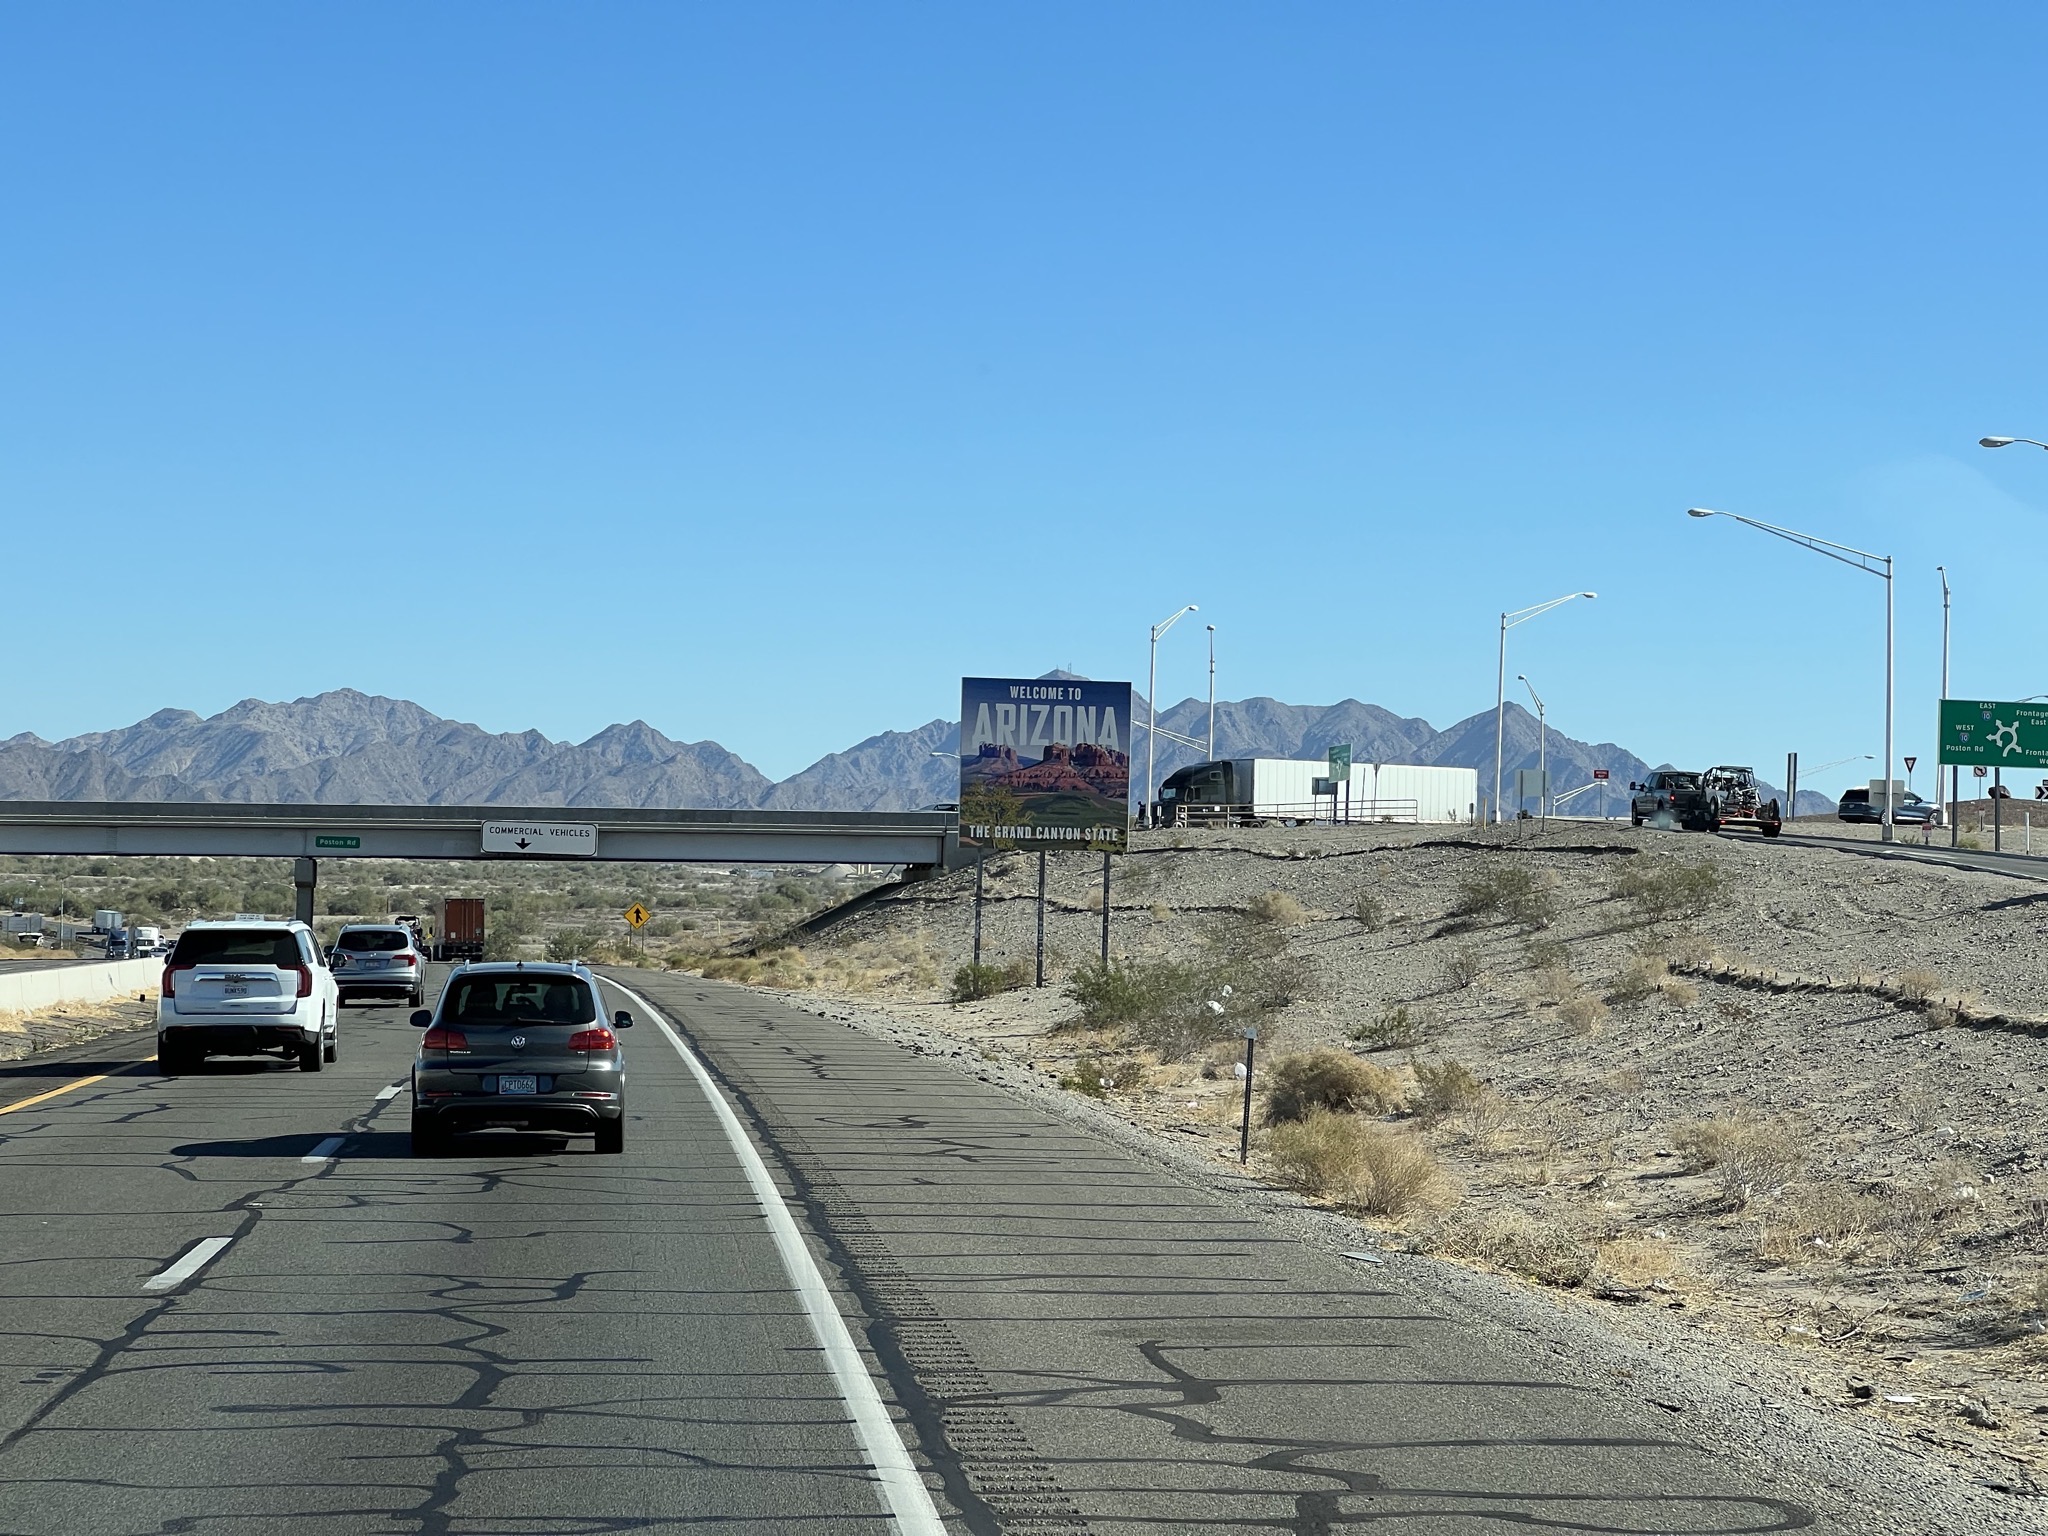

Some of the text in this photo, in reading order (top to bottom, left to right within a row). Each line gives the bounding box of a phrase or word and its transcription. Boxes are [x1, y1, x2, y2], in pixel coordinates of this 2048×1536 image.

[1010, 686, 1081, 700] WELCOME TO
[972, 702, 1119, 750] ARIZONA
[489, 826, 590, 838] COMMERCIAL VEHICLES
[969, 825, 1118, 841] THE GRAND CANYON STATE
[319, 838, 344, 846] Poston
